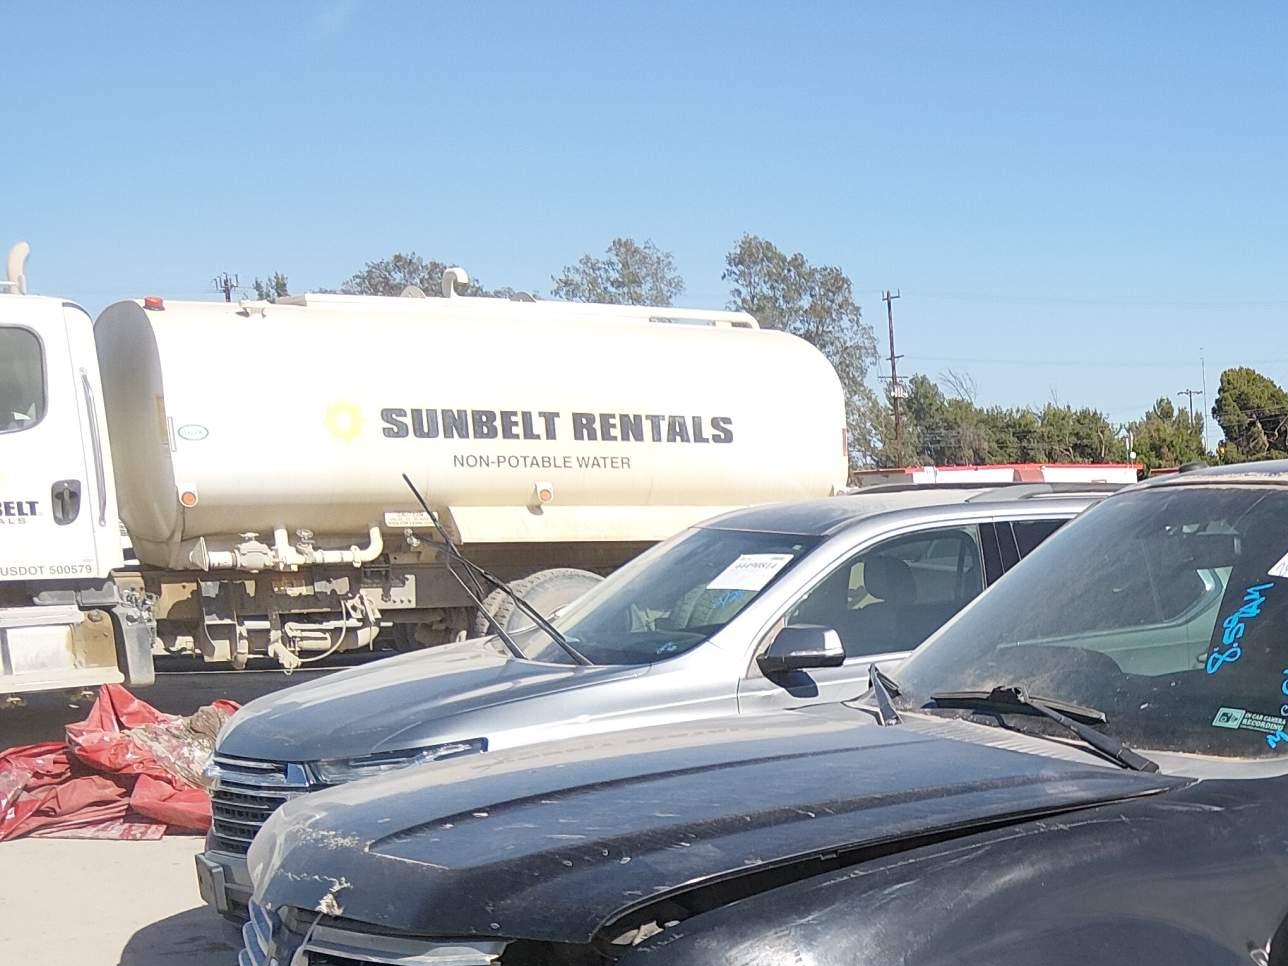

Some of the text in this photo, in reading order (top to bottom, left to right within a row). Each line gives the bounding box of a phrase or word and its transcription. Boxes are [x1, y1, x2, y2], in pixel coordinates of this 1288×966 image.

[381, 408, 734, 444] SUNBELT RENTALS
[453, 454, 631, 470] NON-POTABLE WATER
[0, 566, 44, 576] USDOT
